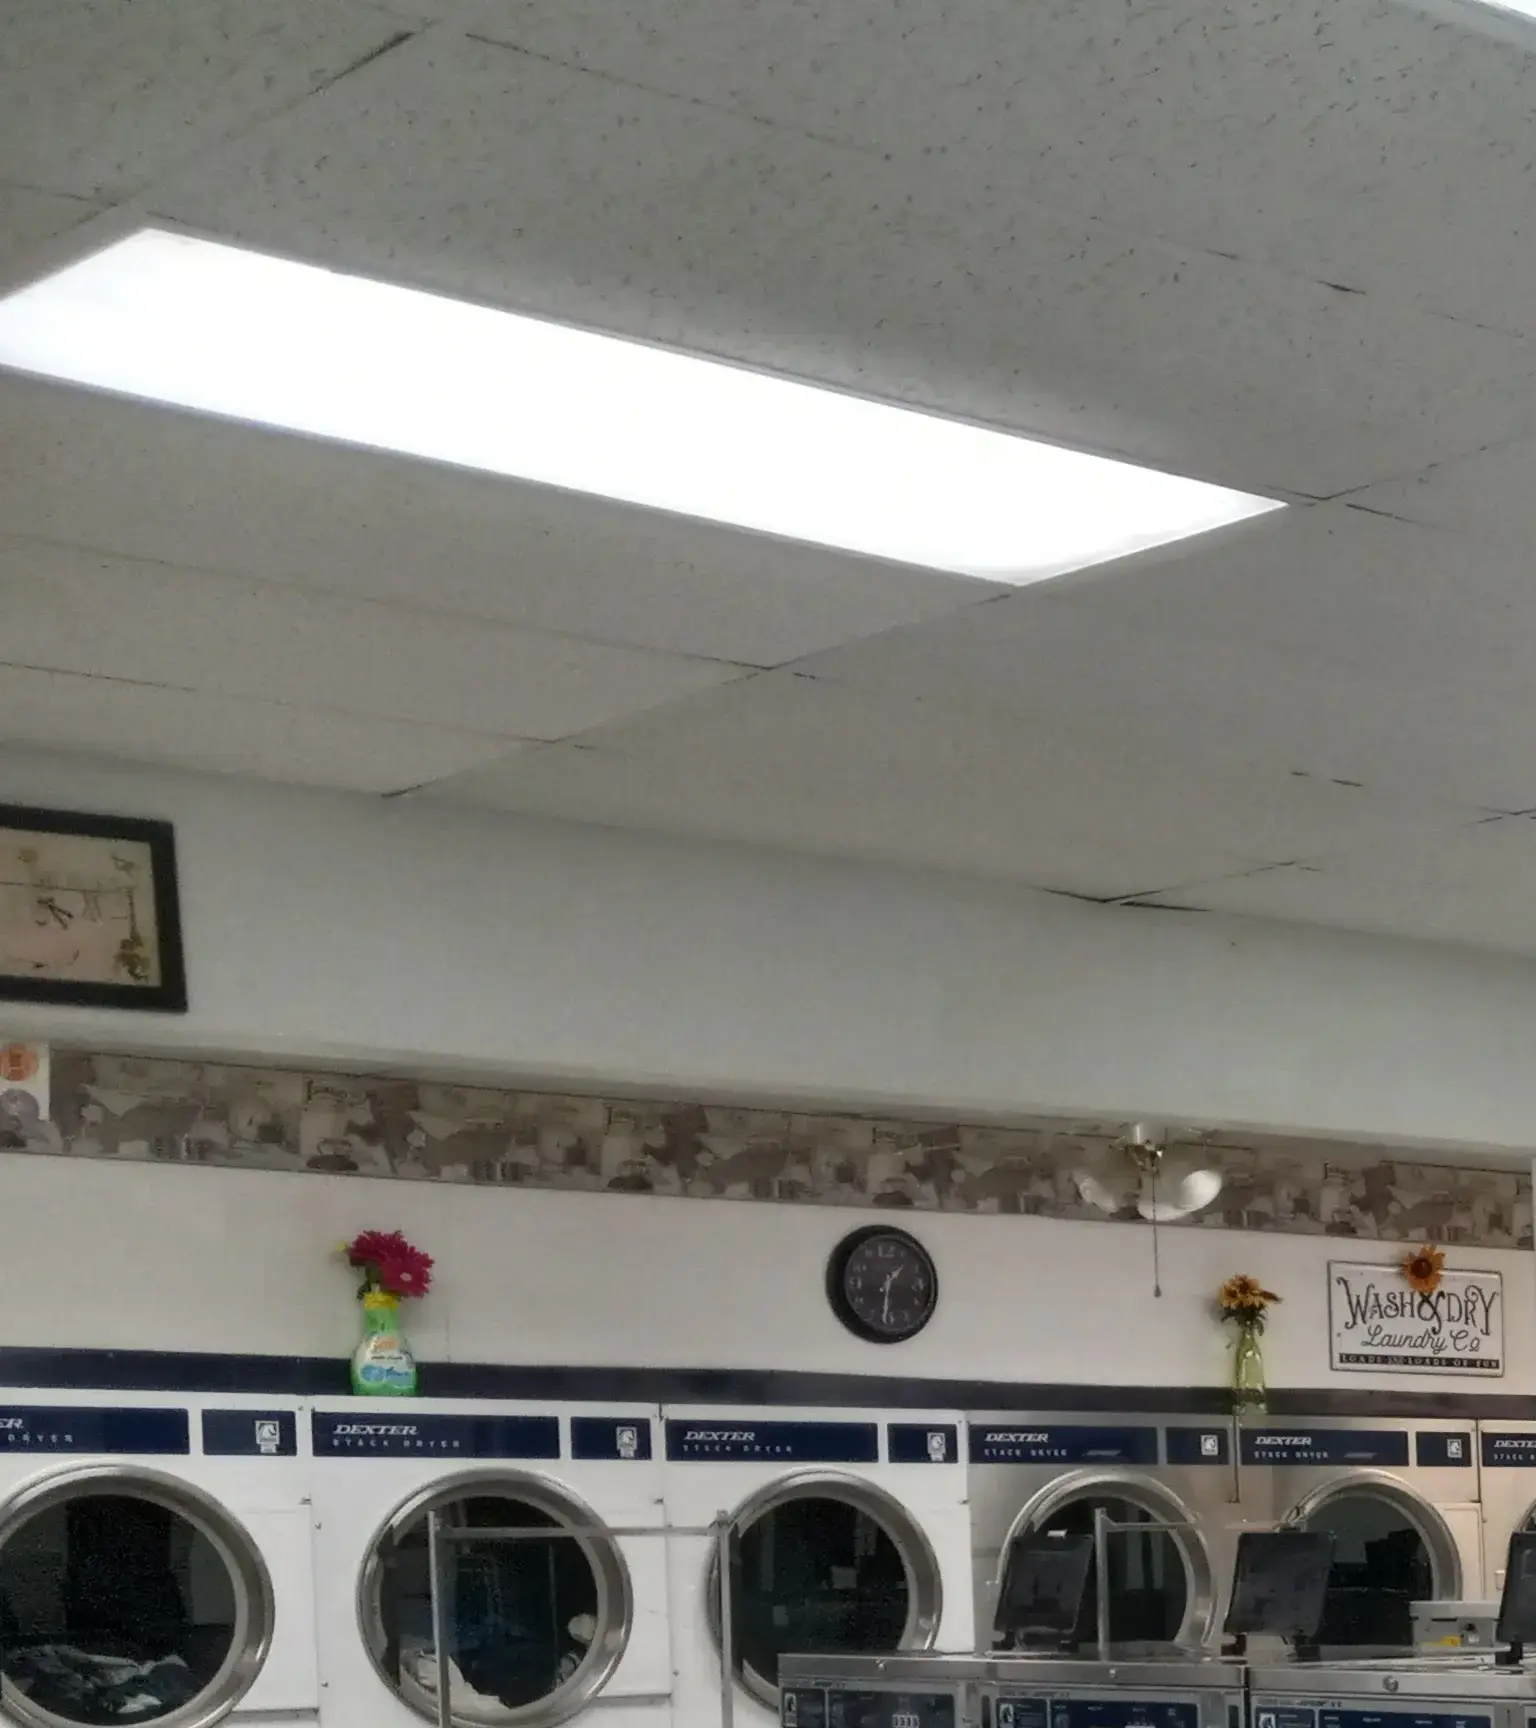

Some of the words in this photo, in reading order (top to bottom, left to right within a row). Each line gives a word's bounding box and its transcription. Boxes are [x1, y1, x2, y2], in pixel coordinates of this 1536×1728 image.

[1336, 1276, 1415, 1330] WASH
[1446, 1284, 1499, 1336] DRY
[1360, 1324, 1447, 1355] Laundry
[333, 1424, 420, 1436] DEXTER
[684, 1431, 755, 1441] DEXTER
[984, 1433, 1049, 1443] DEXTER
[1255, 1436, 1312, 1445] DEXTER
